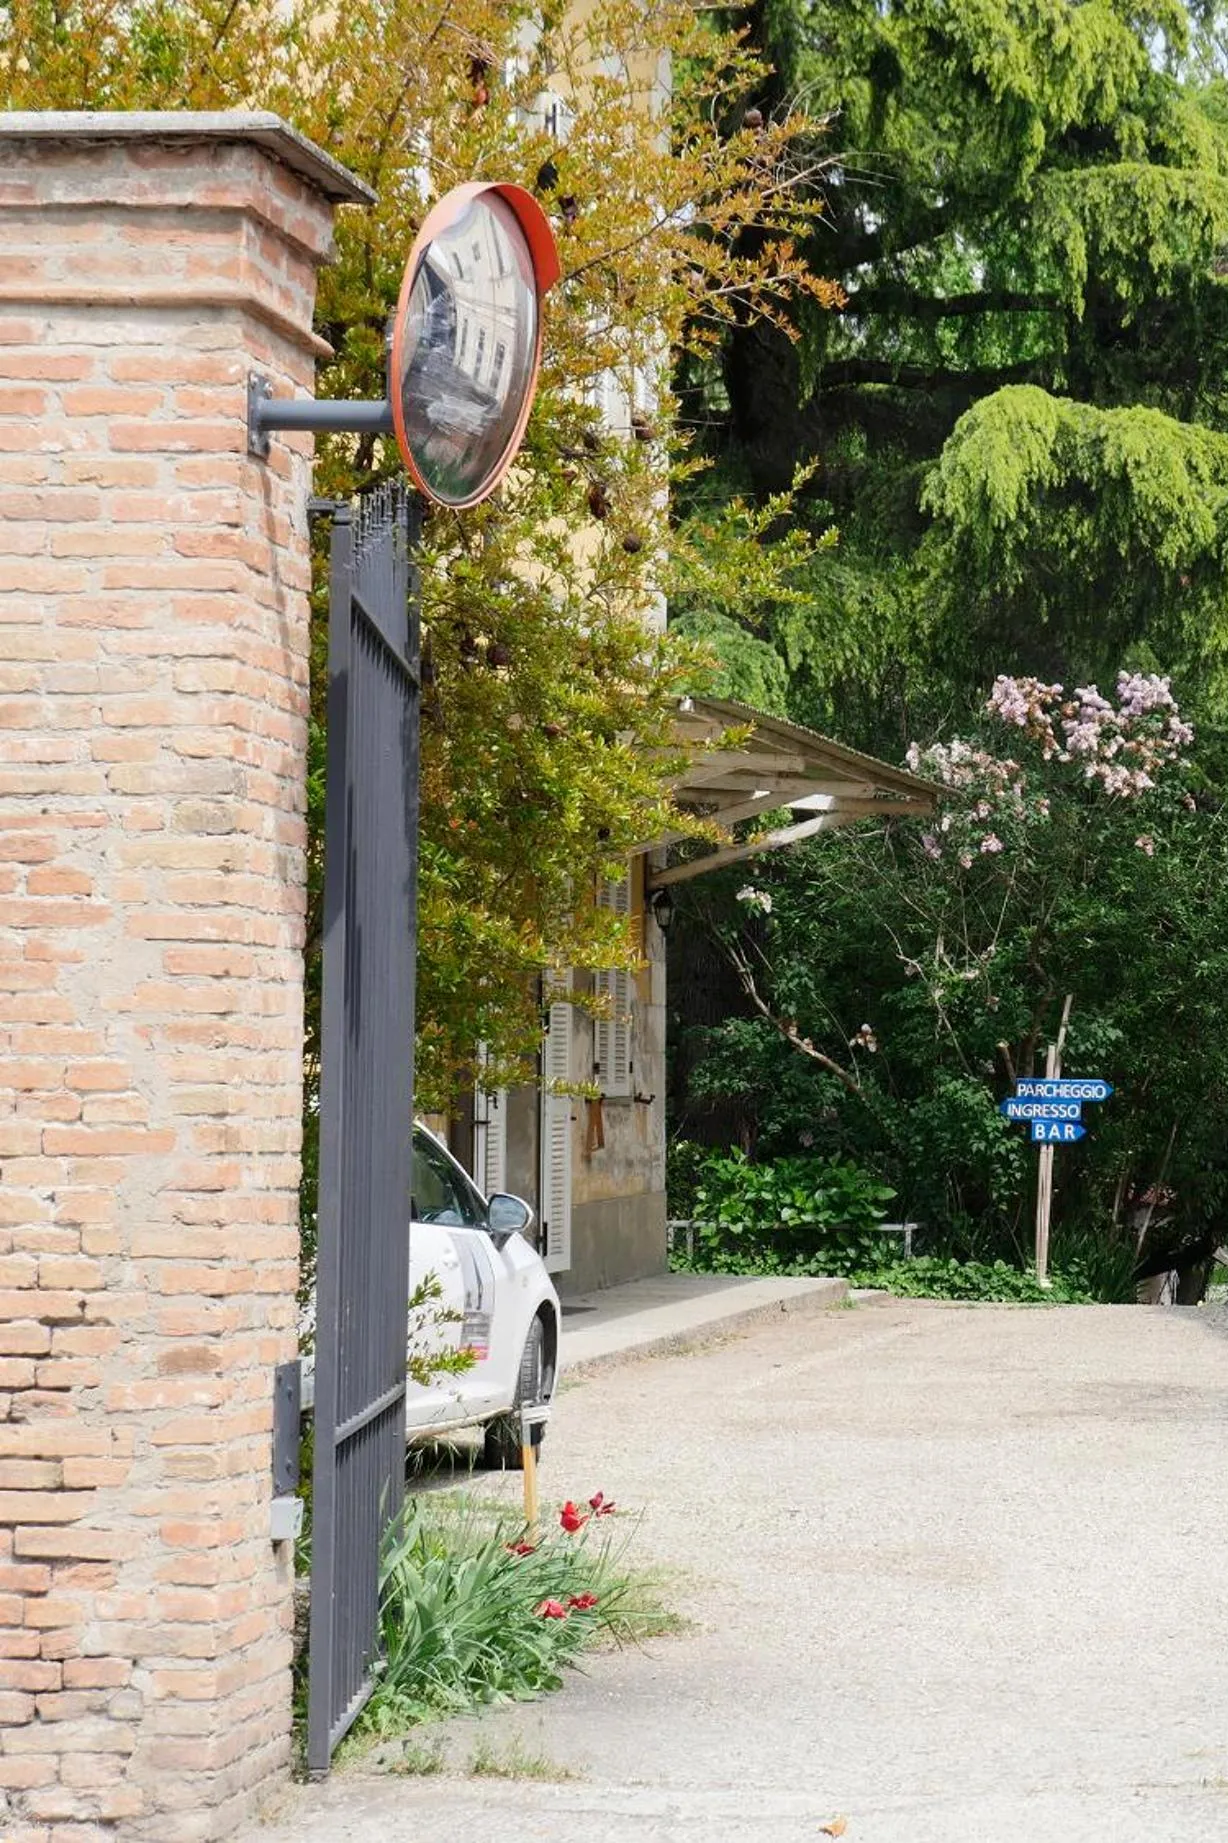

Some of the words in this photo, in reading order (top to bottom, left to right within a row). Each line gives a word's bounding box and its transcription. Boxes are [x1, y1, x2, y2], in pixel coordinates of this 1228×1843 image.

[1017, 1083, 1107, 1099] PARCHEGGIO
[1007, 1103, 1080, 1118] INGRESSO
[1035, 1123, 1076, 1139] BAR
